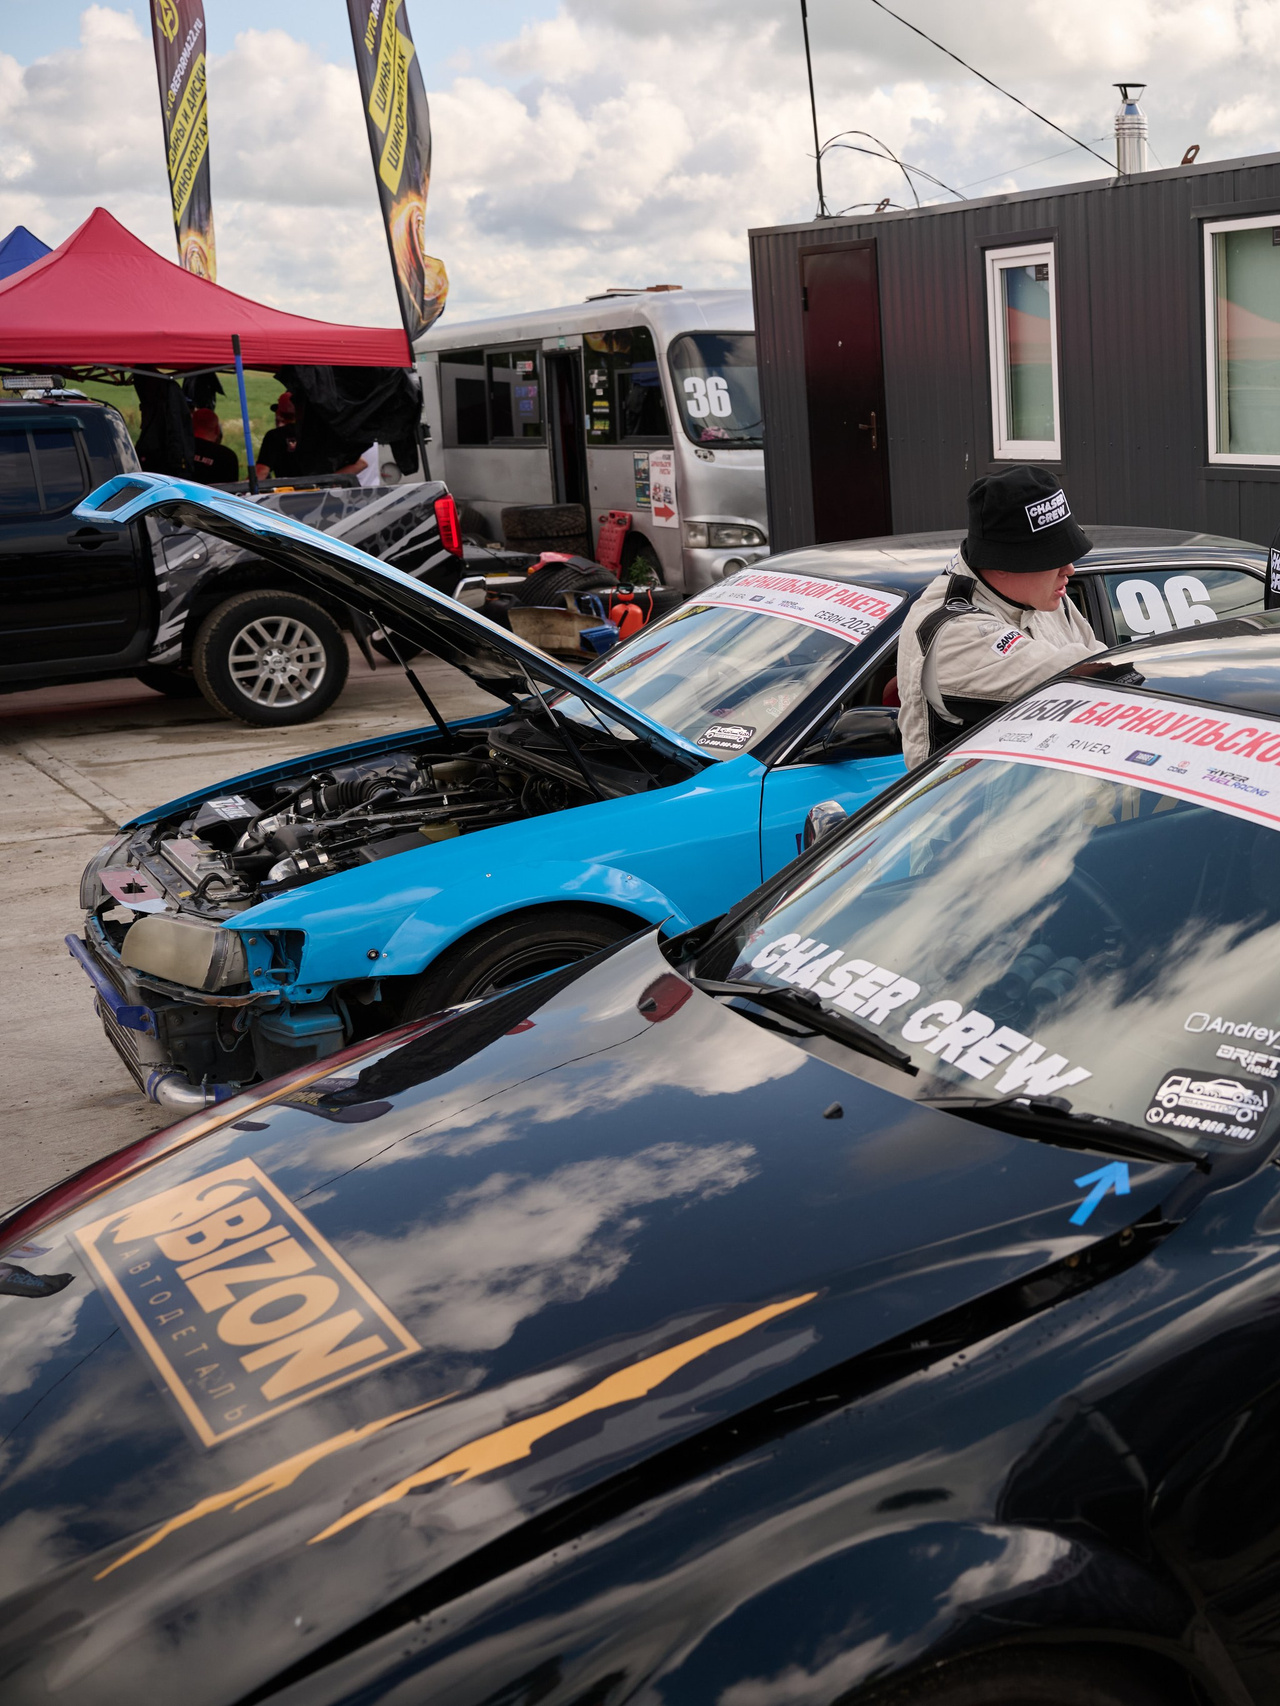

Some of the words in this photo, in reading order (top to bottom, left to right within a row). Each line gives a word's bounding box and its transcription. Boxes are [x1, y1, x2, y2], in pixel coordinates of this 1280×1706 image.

[683, 376, 733, 418] 36
[1038, 505, 1066, 525] CREW
[814, 610, 846, 624] СЕЗОН
[1116, 575, 1218, 641] 96
[998, 699, 1091, 723] КУБОК
[1067, 739, 1111, 755] RIVER
[751, 933, 921, 1026] CHASER
[901, 1000, 1093, 1100] CREW
[1246, 1062, 1278, 1078] news
[154, 1195, 390, 1402] BIZON
[116, 1247, 249, 1423] АВТОДЕТАЛЬ
